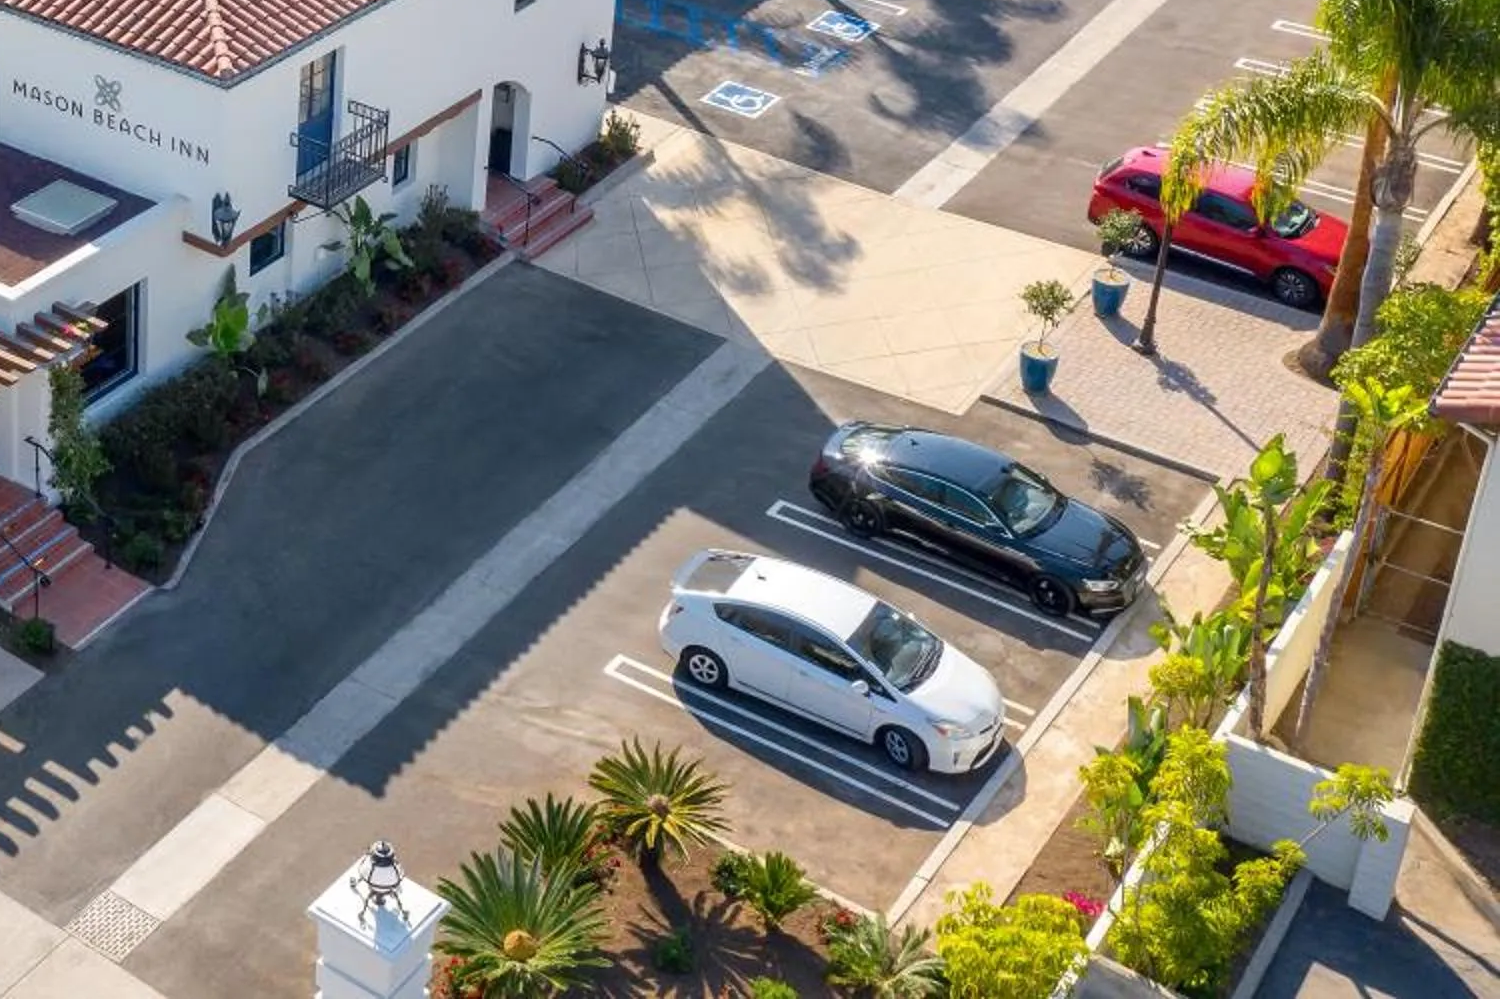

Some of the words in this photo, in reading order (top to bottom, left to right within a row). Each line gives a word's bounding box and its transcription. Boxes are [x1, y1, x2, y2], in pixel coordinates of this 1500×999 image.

[12, 79, 83, 118] MASON
[93, 108, 161, 147] BEACH
[171, 136, 210, 166] INN
